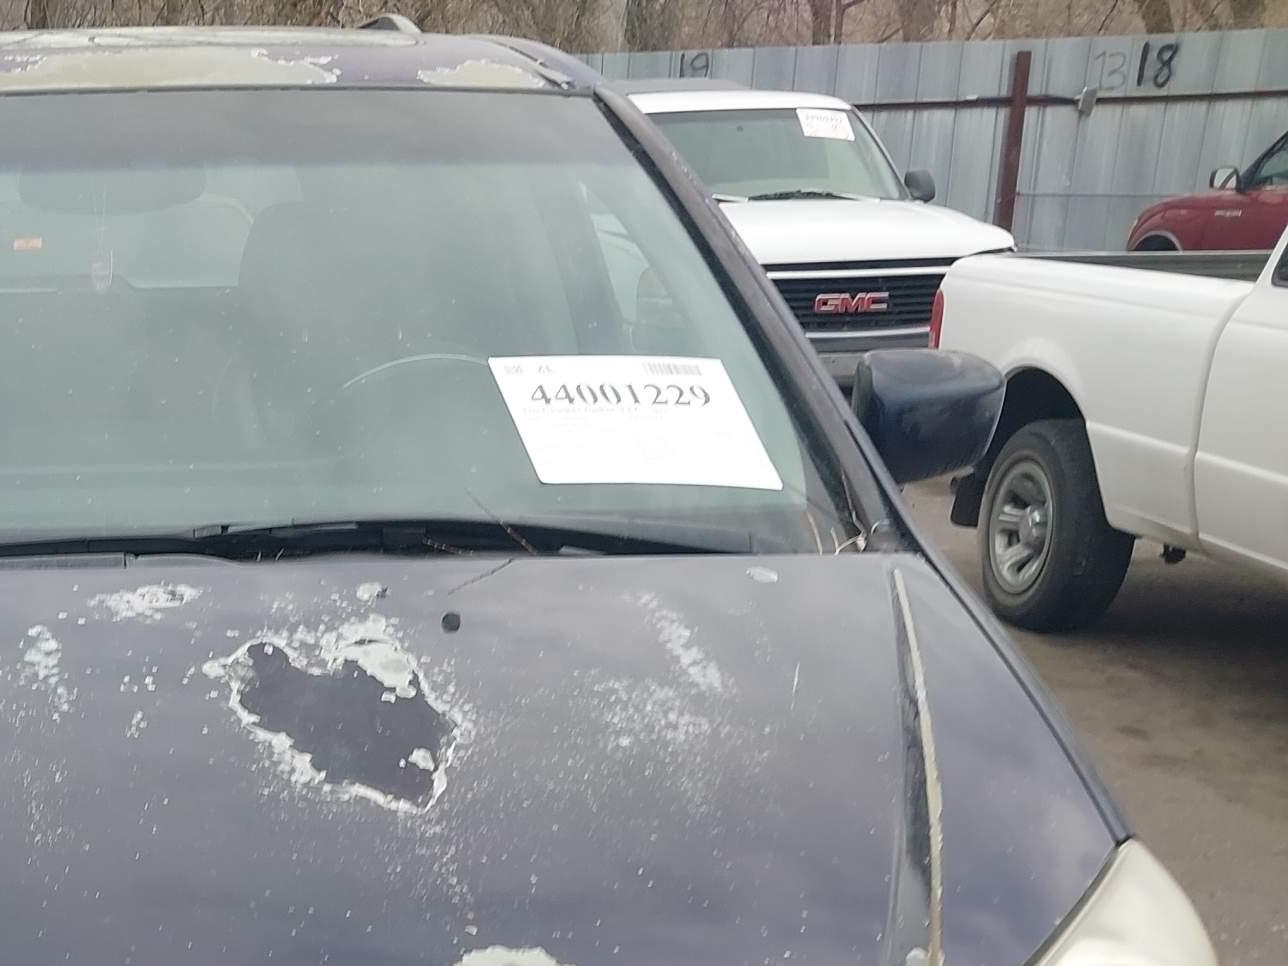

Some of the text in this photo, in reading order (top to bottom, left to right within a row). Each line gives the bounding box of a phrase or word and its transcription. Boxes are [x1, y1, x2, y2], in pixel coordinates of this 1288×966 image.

[679, 52, 709, 78] 19
[1137, 41, 1179, 88] 18
[814, 291, 889, 313] GMC
[530, 383, 711, 406] 44001229
